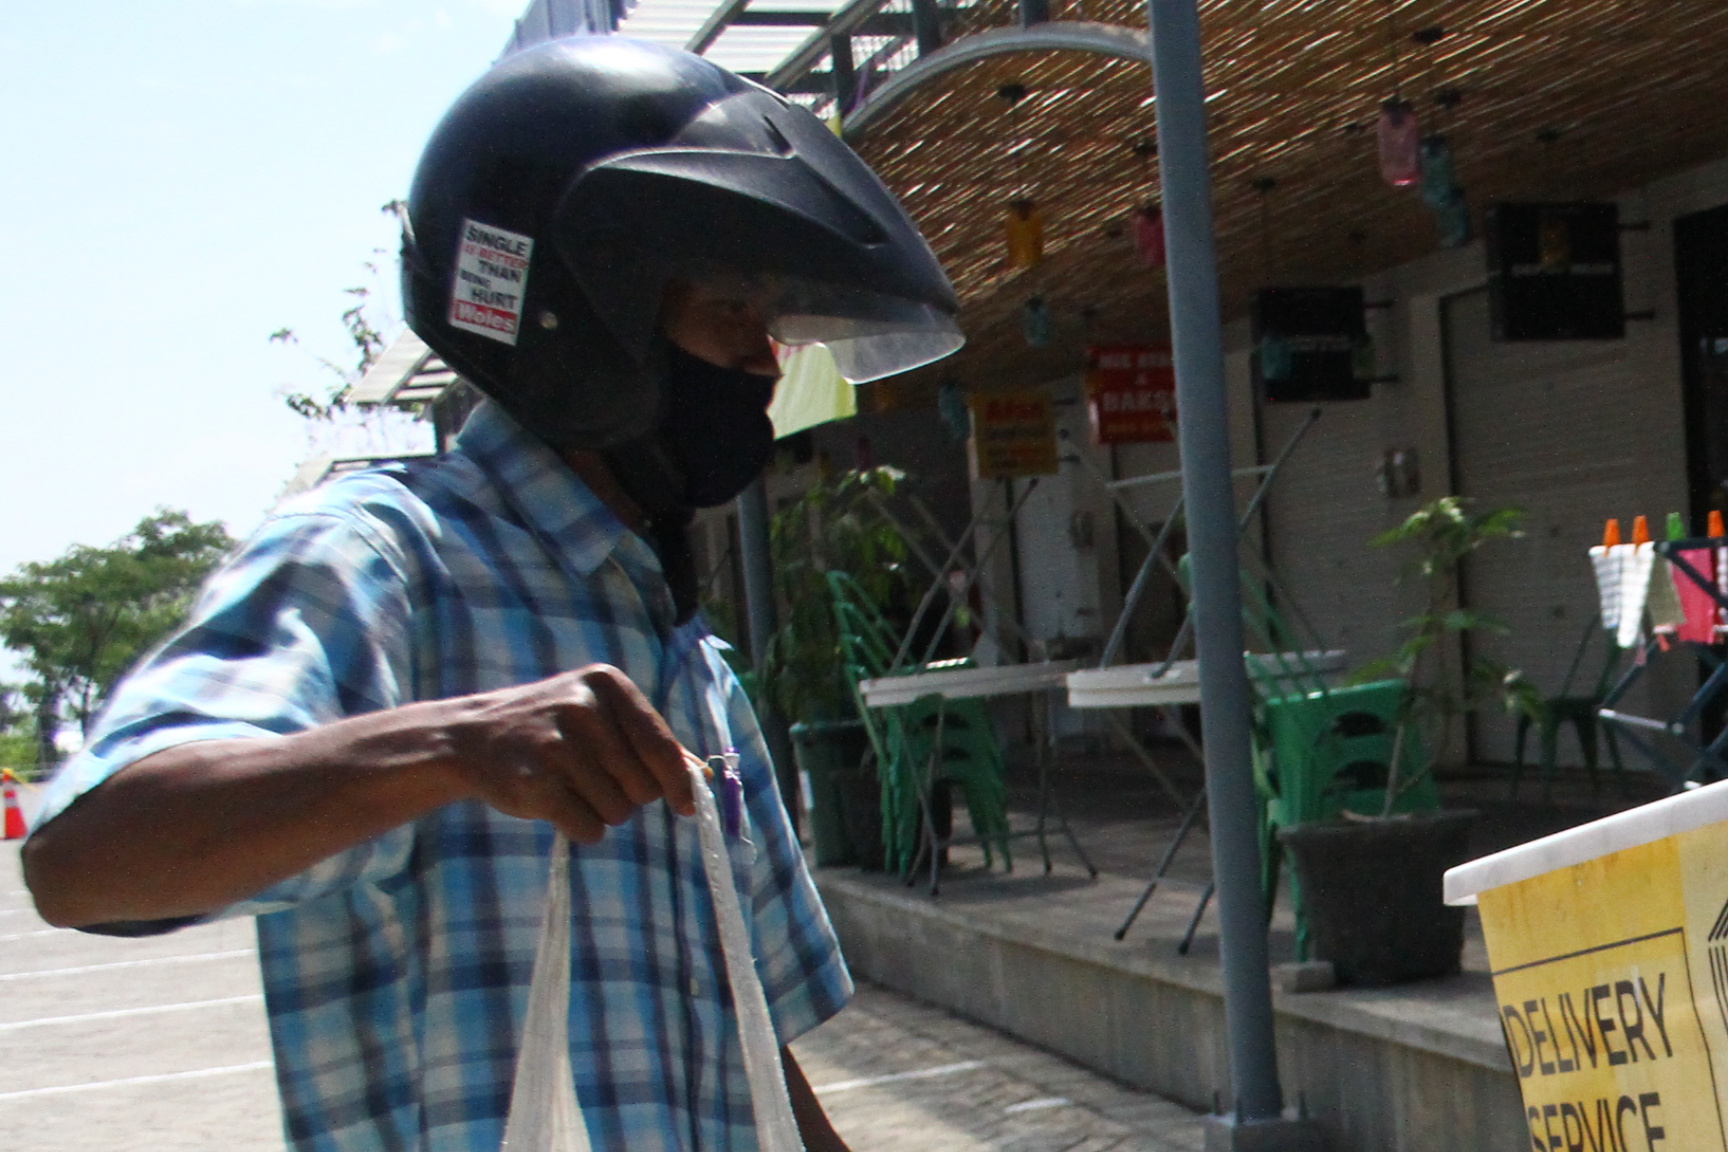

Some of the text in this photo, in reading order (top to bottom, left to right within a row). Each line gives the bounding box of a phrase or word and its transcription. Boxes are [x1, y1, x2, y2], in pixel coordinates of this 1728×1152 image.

[466, 226, 528, 257] SINGLE
[479, 247, 529, 270] BETTER
[459, 268, 491, 289] BEING
[477, 260, 521, 283] THAN
[471, 288, 517, 310] HURT
[458, 303, 516, 332] Woles
[1504, 971, 1675, 1079] DELIVERY
